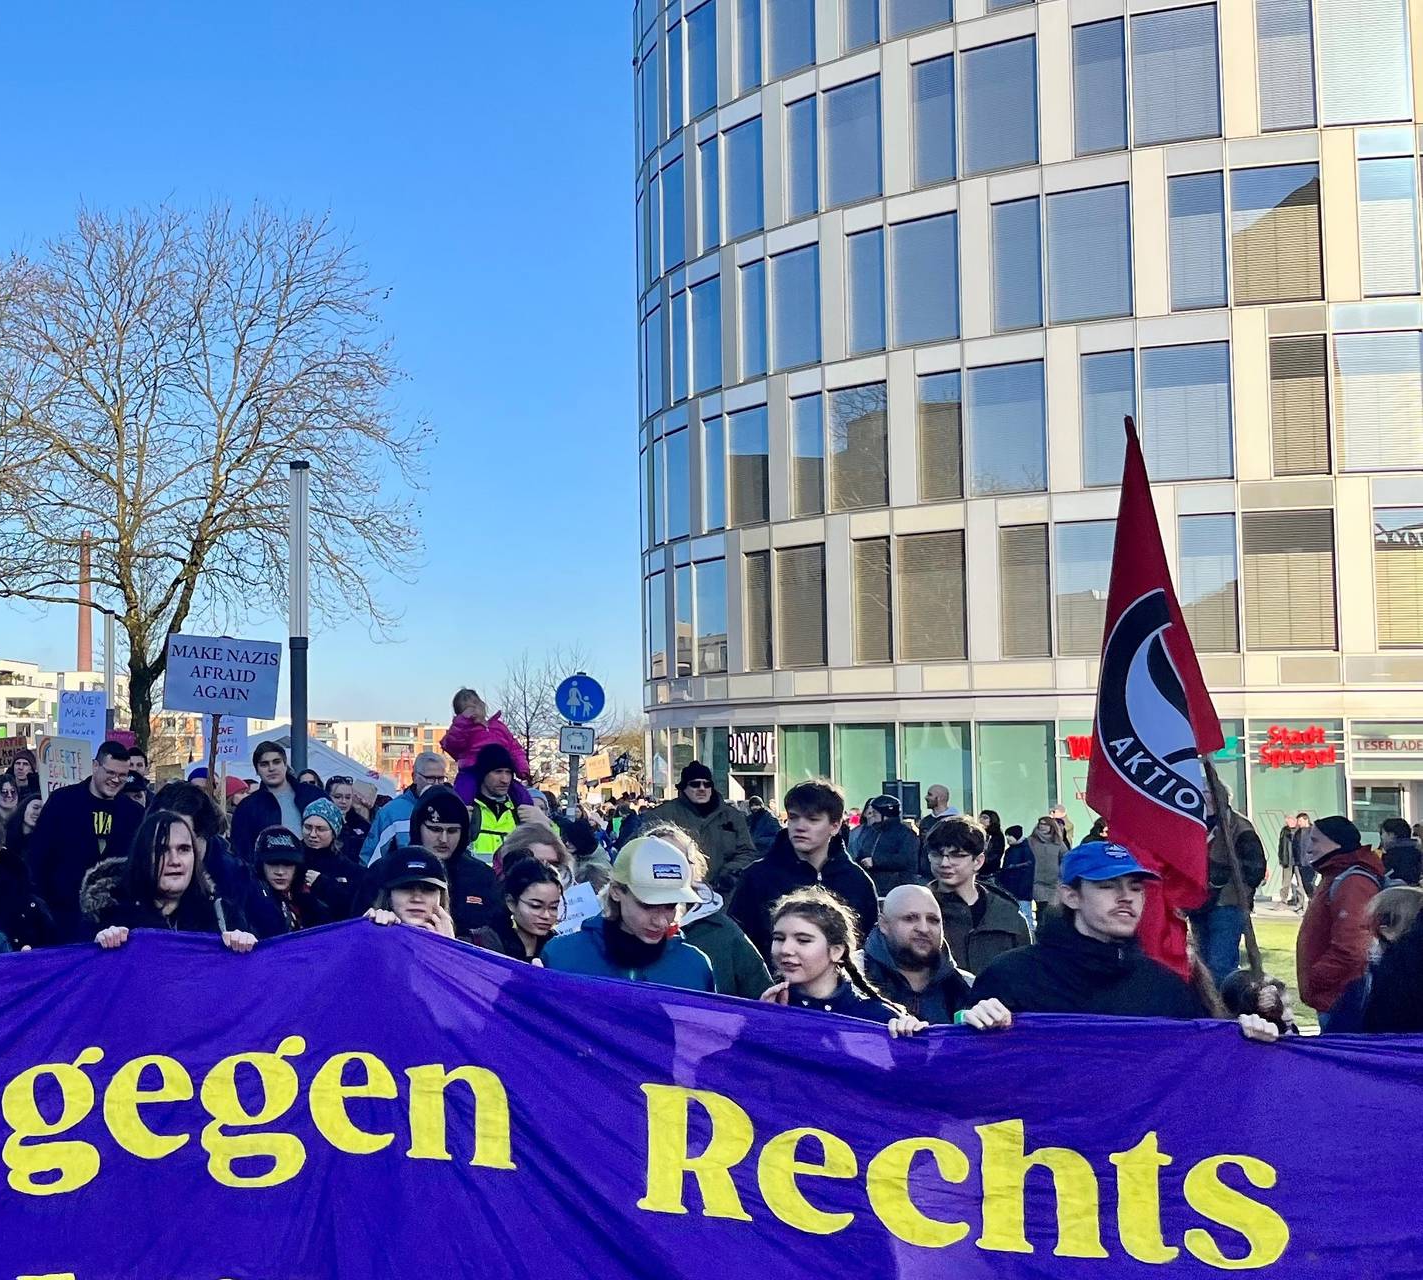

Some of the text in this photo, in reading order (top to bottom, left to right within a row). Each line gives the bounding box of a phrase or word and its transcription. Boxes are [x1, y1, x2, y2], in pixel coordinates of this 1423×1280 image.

[171, 644, 278, 666] MAKE NAZIS
[190, 665, 256, 683] AFRAID
[192, 685, 249, 701] AGAIN
[1267, 725, 1325, 745] Stadt
[1260, 743, 1336, 769] Spiegel
[1109, 736, 1207, 822] AKTIO
[1, 1035, 517, 1196] gegen
[637, 1083, 1289, 1270] Rechts
